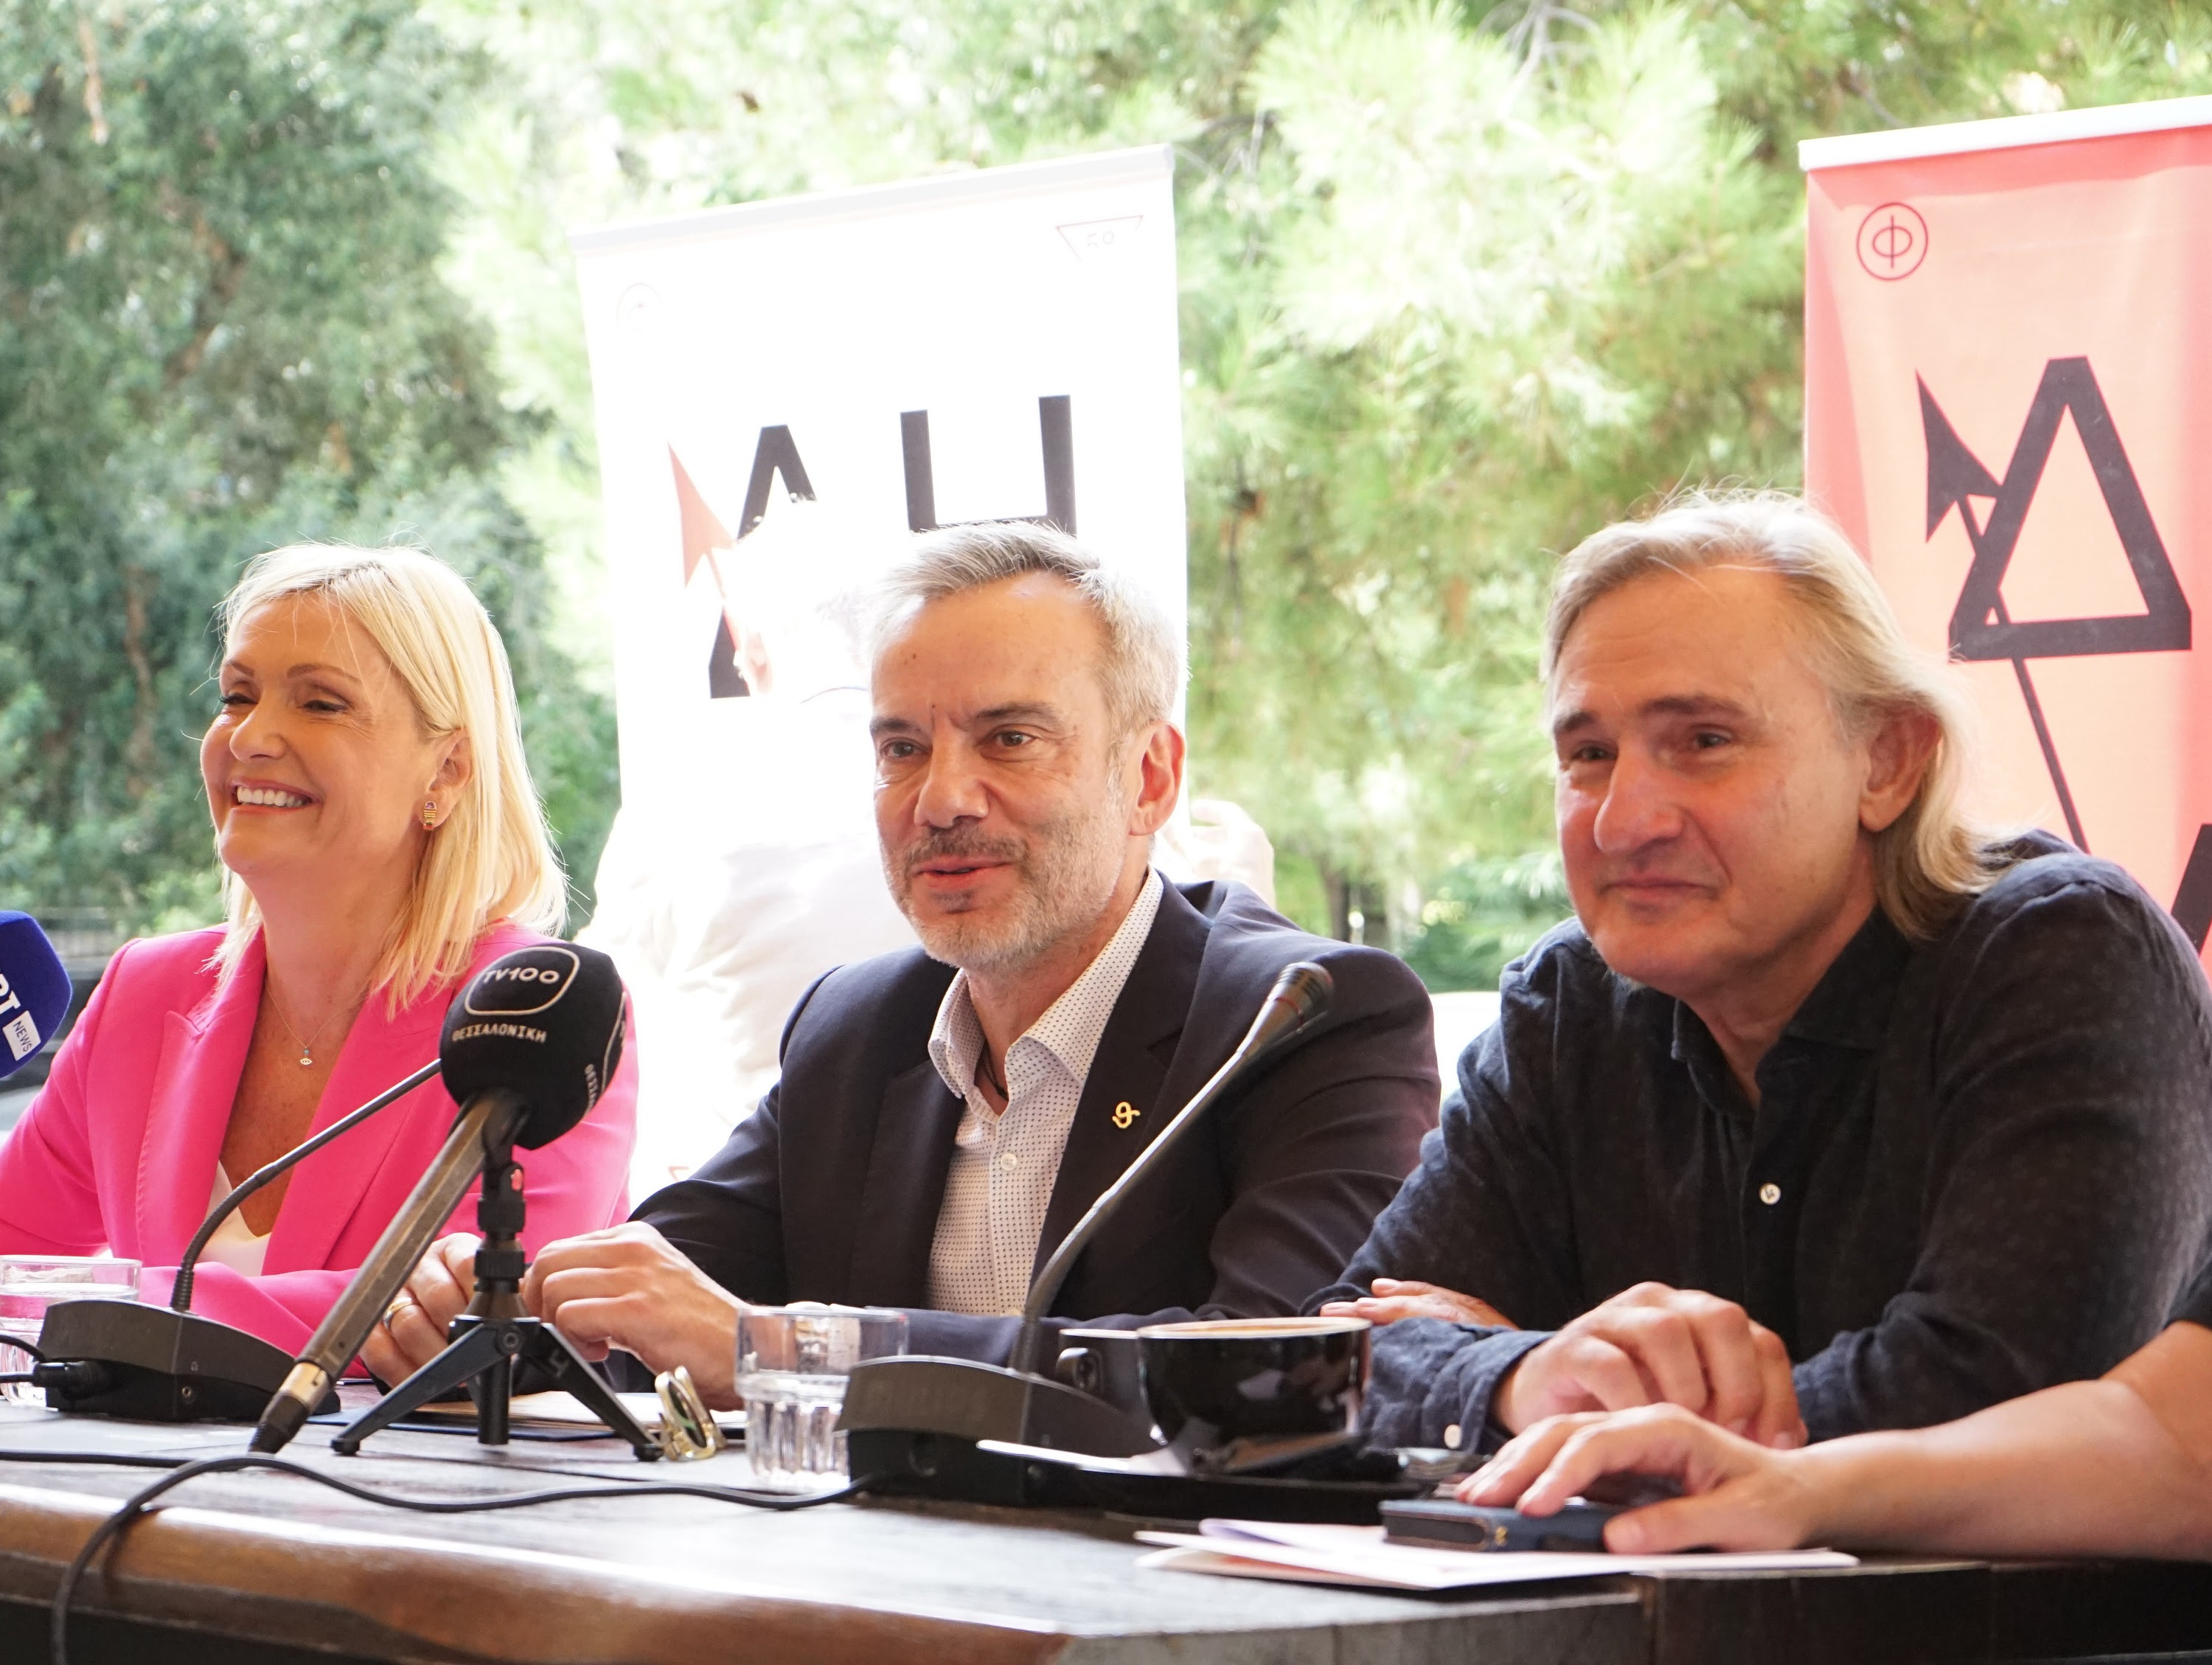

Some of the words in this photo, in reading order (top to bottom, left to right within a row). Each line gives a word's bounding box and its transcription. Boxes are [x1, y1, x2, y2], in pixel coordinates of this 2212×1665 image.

[484, 967, 560, 984] TV100
[13, 1021, 32, 1052] NEWS
[451, 1023, 547, 1043] ΘΕΣΣΑΛΟΝΙΚΗ
